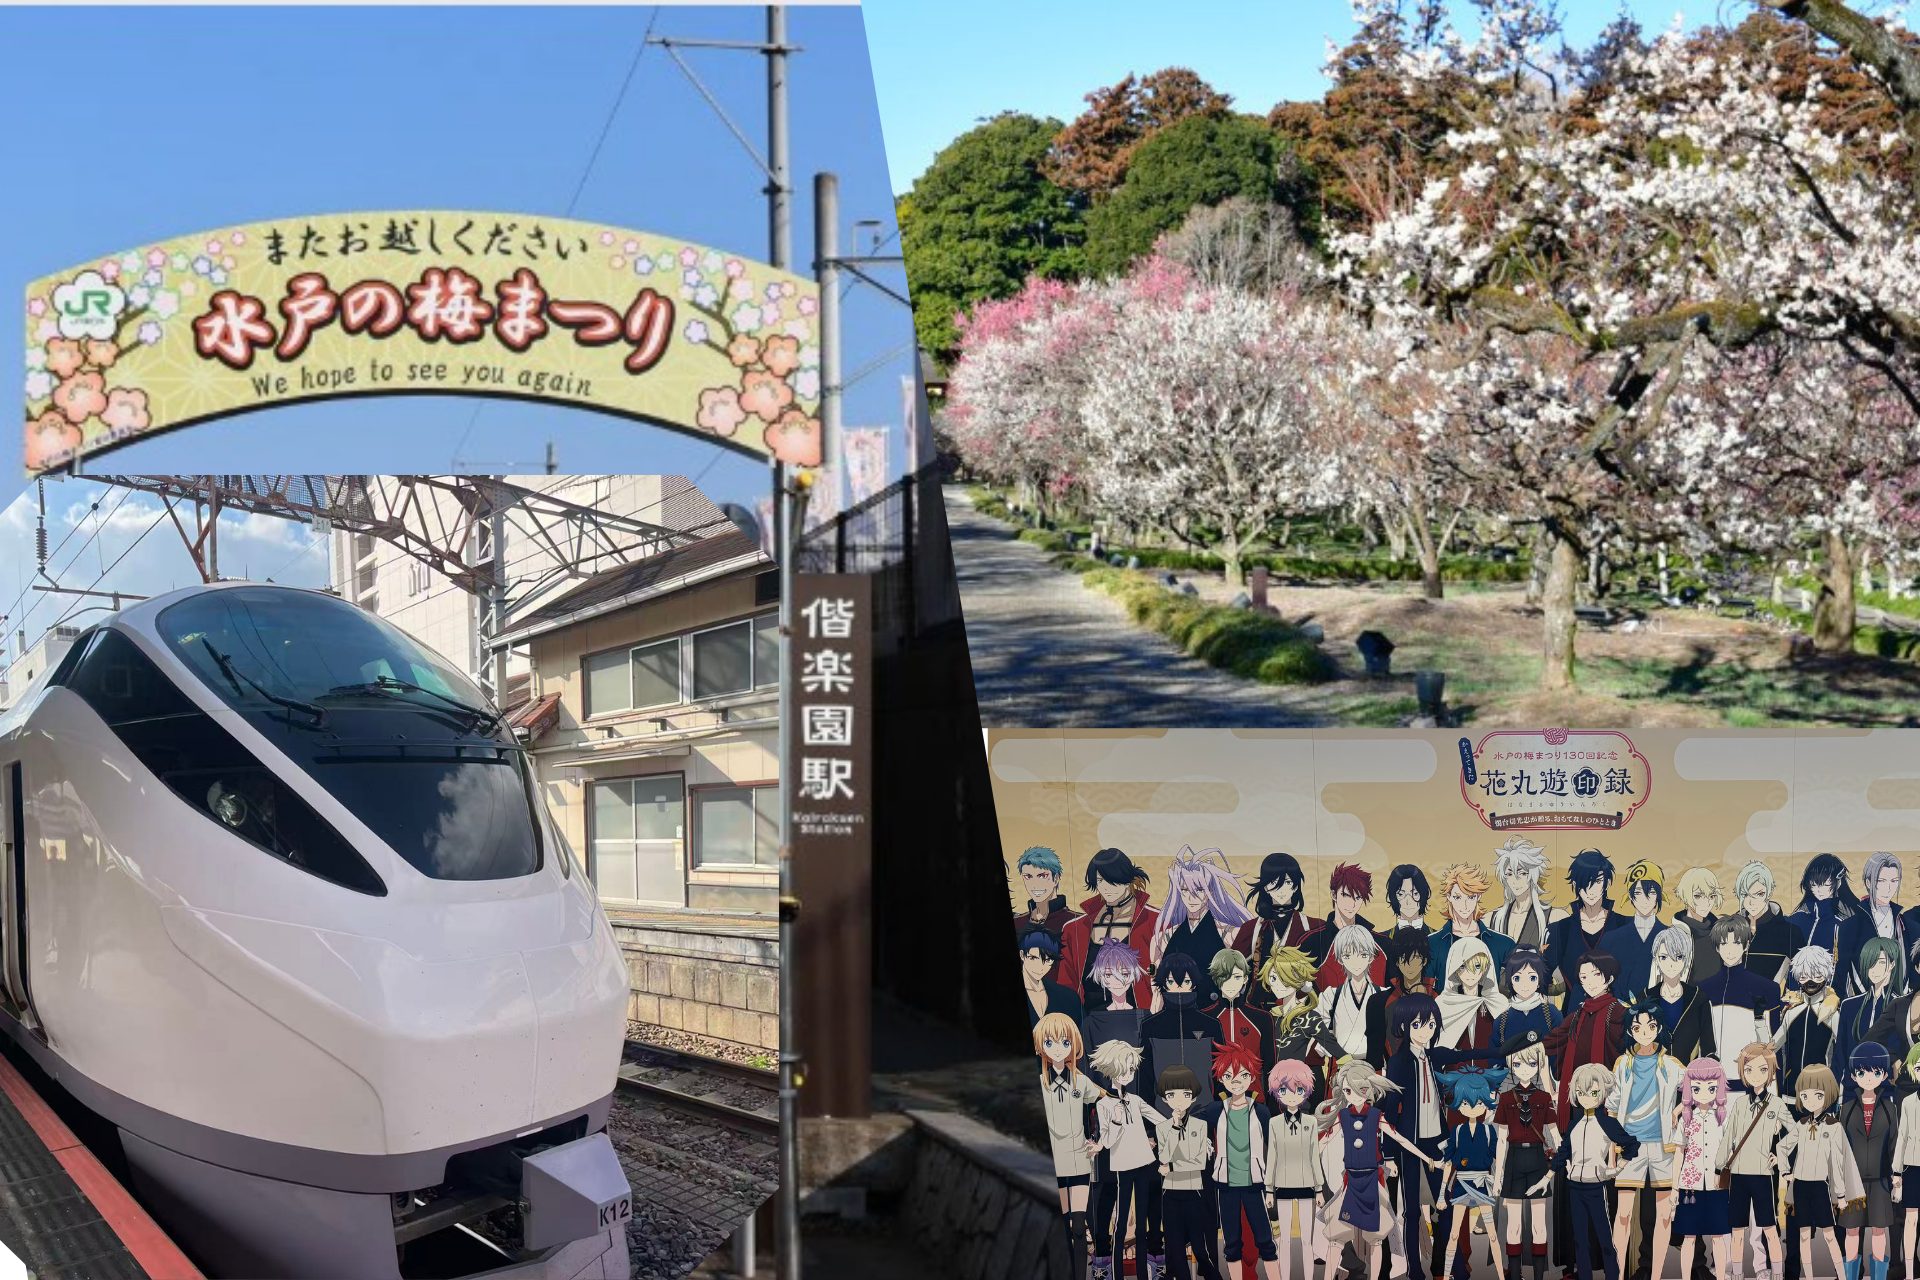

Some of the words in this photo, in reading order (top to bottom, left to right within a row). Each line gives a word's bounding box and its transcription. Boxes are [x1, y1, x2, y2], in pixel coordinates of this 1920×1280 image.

[264, 217, 588, 265] またお越しください
[64, 290, 110, 316] JR
[192, 266, 676, 375] 水戸の梅まつり
[252, 373, 288, 396] We
[301, 366, 356, 390] hope
[370, 359, 393, 381] to
[407, 364, 447, 382] see
[463, 364, 504, 384] you
[518, 369, 592, 396] again
[799, 597, 854, 801] 偕楽園駅
[1493, 751, 1618, 761] 水戸の梅まつり130回記念
[1480, 767, 1635, 797] 花丸遊印録
[600, 1199, 629, 1227] K12
